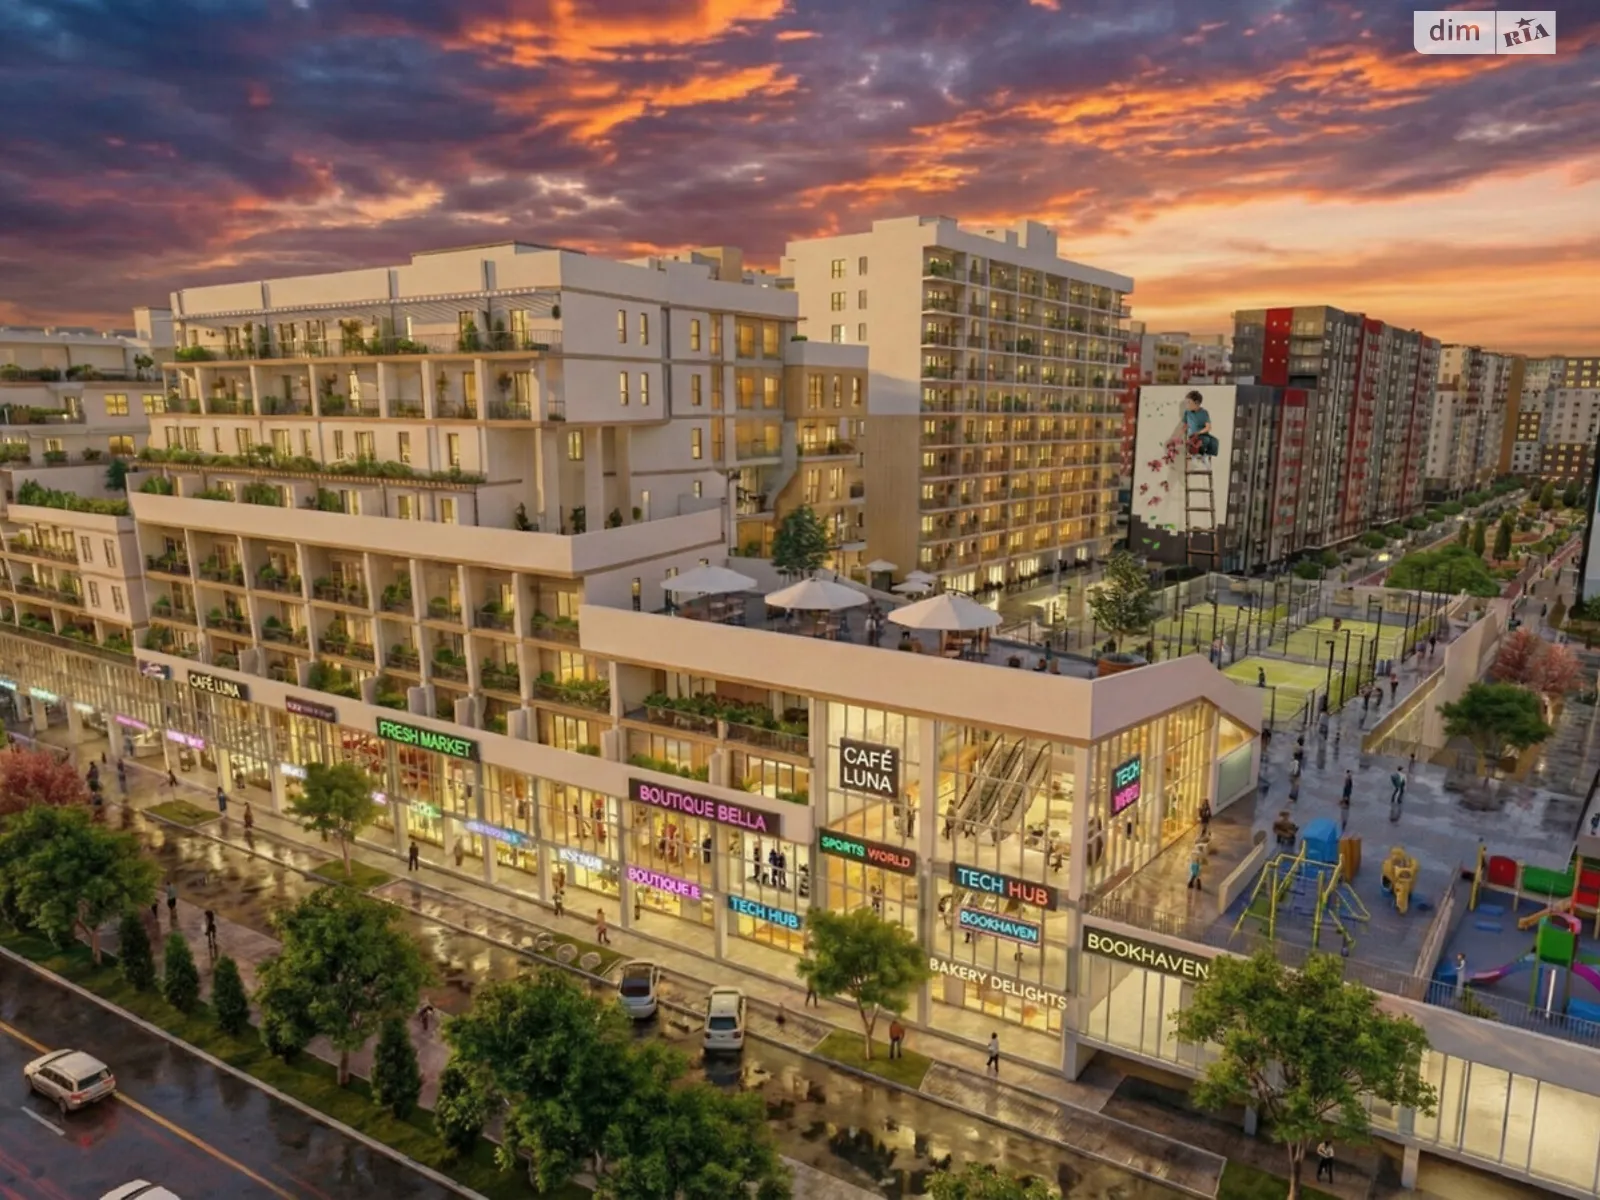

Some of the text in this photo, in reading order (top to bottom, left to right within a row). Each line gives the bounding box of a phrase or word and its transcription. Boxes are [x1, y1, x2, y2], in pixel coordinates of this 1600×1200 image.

[214, 680, 241, 698] LUNA
[380, 721, 471, 757] FRESH MARKET
[843, 746, 893, 772] CAFÉ
[843, 767, 893, 793] LUNA
[640, 785, 766, 832] BOUTIQUE BELLA
[821, 836, 910, 868] SPORTS WORLD
[627, 867, 689, 896] BOUTIQUE
[958, 868, 1048, 905] TECH HUB
[731, 896, 799, 927] TECH HUB
[960, 911, 1037, 941] BOOKHAVEN
[1087, 932, 1209, 979] BOOKHAVEN
[929, 957, 1067, 1010] BAKERY DELIGHTS
